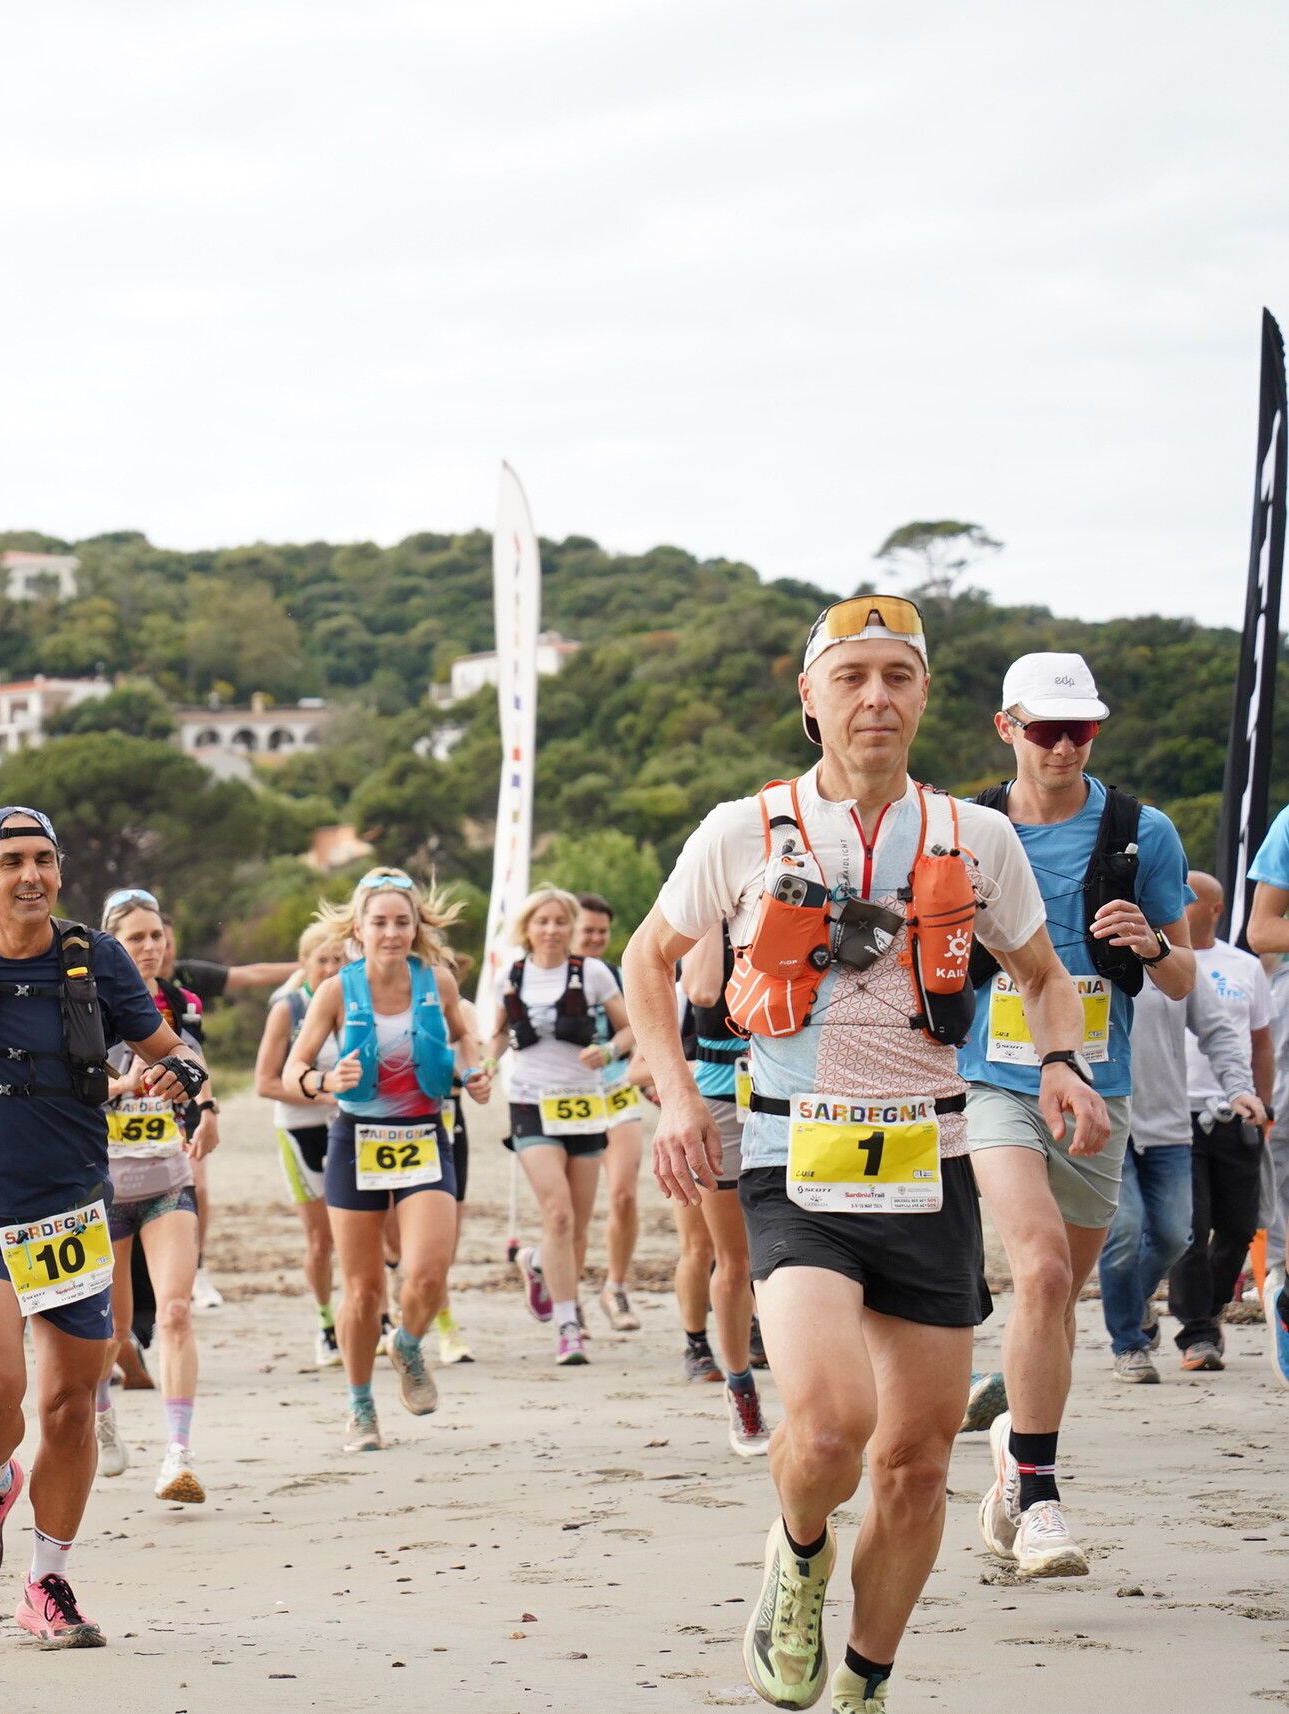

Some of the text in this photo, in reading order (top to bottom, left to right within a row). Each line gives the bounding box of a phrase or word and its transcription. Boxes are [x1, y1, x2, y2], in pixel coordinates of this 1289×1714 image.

[936, 967, 967, 978] KAIL
[557, 1099, 591, 1119] 53
[799, 1101, 927, 1123] SARDEGNA
[122, 1118, 166, 1141] 59
[376, 1144, 421, 1170] 62
[858, 1131, 885, 1176] 1
[845, 1191, 885, 1199] SardiniaTrail
[36, 1237, 86, 1281] 10
